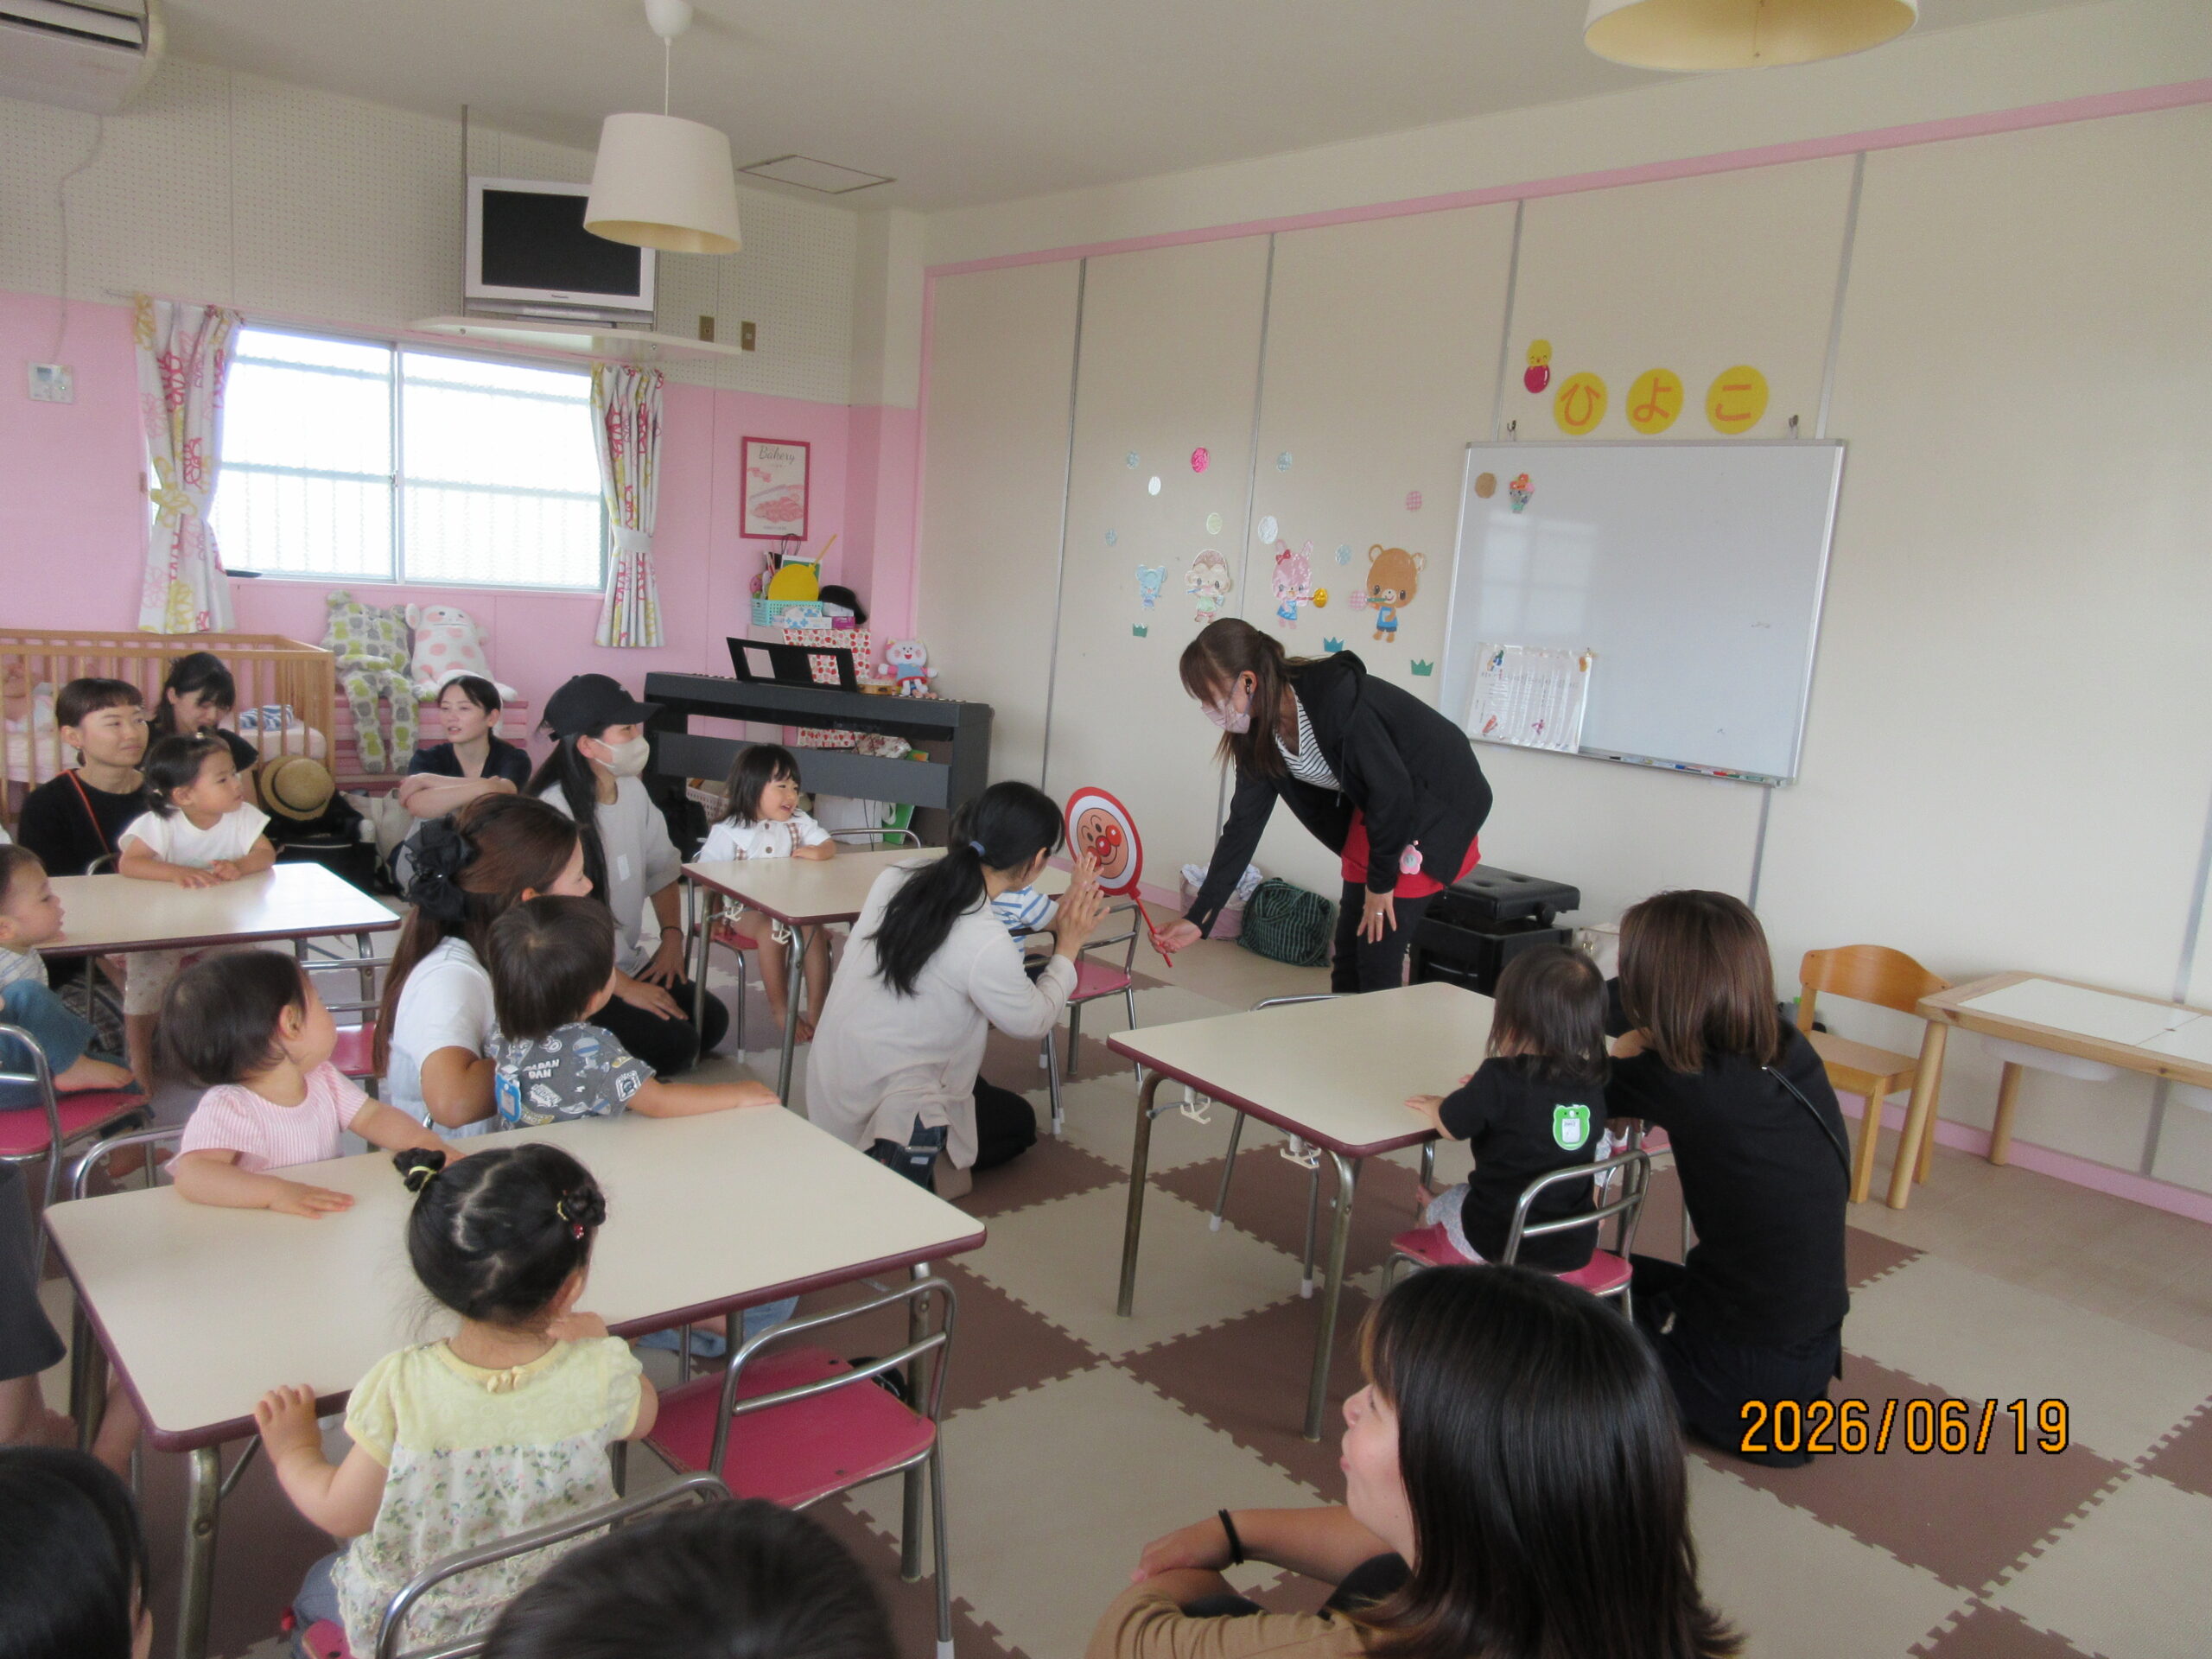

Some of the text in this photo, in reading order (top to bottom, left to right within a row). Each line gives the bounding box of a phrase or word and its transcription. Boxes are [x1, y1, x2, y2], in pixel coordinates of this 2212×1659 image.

[1560, 378, 1752, 427] ひよこ
[759, 445, 795, 465] Bakery
